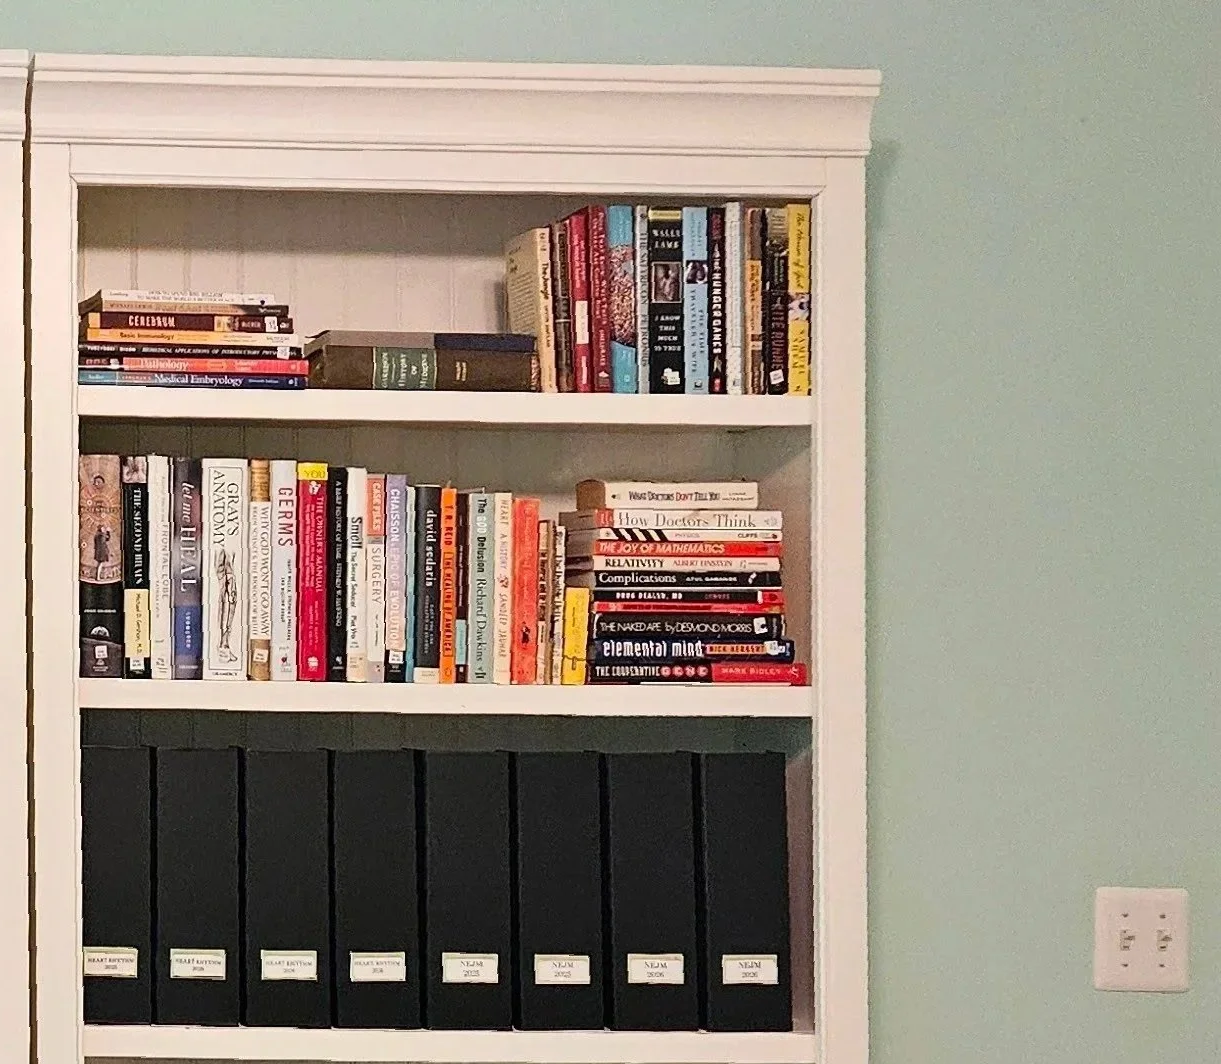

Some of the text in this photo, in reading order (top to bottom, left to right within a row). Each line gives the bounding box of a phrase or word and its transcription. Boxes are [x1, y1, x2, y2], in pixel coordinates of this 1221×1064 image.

[541, 275, 549, 300] Jungle
[128, 315, 175, 327] CEREBRUM
[712, 273, 721, 354] HUNGER GAMES
[155, 374, 244, 387] Medical Embryology
[213, 470, 226, 547] ANATOMY
[226, 483, 239, 536] GRAY'S
[278, 487, 294, 546] GERMS
[477, 498, 486, 513] The
[619, 512, 756, 528] How Doctors Think
[133, 488, 143, 584] THE SECOND BRAIN
[180, 481, 196, 592] let me HEAL
[351, 517, 363, 549] Smell
[426, 510, 437, 542] david
[477, 537, 486, 572] Delusion
[599, 543, 725, 553] THE JOY OF MATHEMATICS
[605, 559, 664, 568] RELATIVITY
[260, 507, 270, 635] WHY GOD WON'T GO AWAY
[371, 547, 382, 604] SURGERY
[390, 489, 401, 650] CHAISSON EPIC OF EVOLUTION
[425, 546, 437, 587] sedaris
[599, 573, 677, 584] Complications
[476, 578, 487, 617] Richard
[476, 620, 487, 662] Dawkins
[721, 623, 753, 632] MORRIS
[603, 640, 703, 658] elemental mind
[596, 664, 660, 677] THE COOPERATIVE
